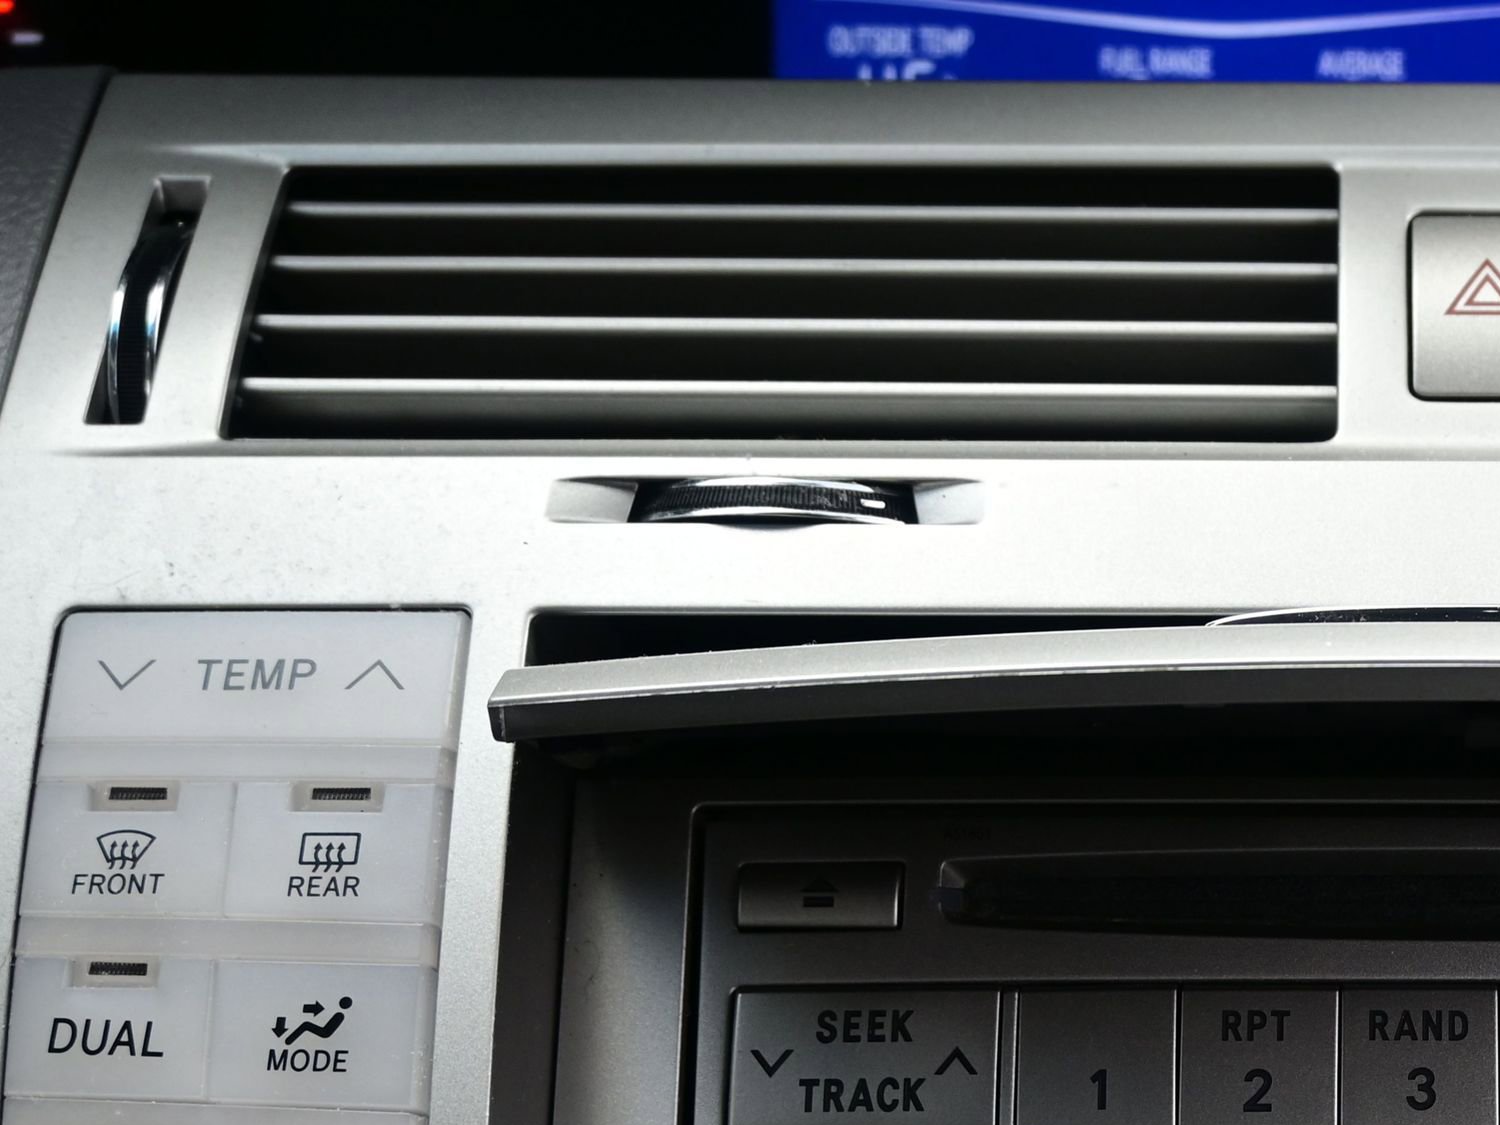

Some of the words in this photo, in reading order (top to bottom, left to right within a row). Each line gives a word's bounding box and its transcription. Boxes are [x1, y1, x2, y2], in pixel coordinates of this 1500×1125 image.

[828, 25, 911, 57] OUTSIDE
[918, 25, 974, 57] TEMP
[1317, 49, 1405, 80] AVERAGE
[198, 659, 316, 690] TEMP
[72, 874, 164, 894] FRONT
[288, 876, 359, 896] REAR
[48, 1018, 163, 1057] DUAL
[816, 1009, 914, 1043] SEEK
[1222, 1010, 1290, 1041] RPT
[1369, 1010, 1468, 1041] RAND
[267, 1049, 348, 1072] MODE
[799, 1077, 926, 1112] TRACK
[1090, 1069, 1107, 1110] 1
[1243, 1069, 1272, 1112] 2
[1406, 1067, 1436, 1110] 3
